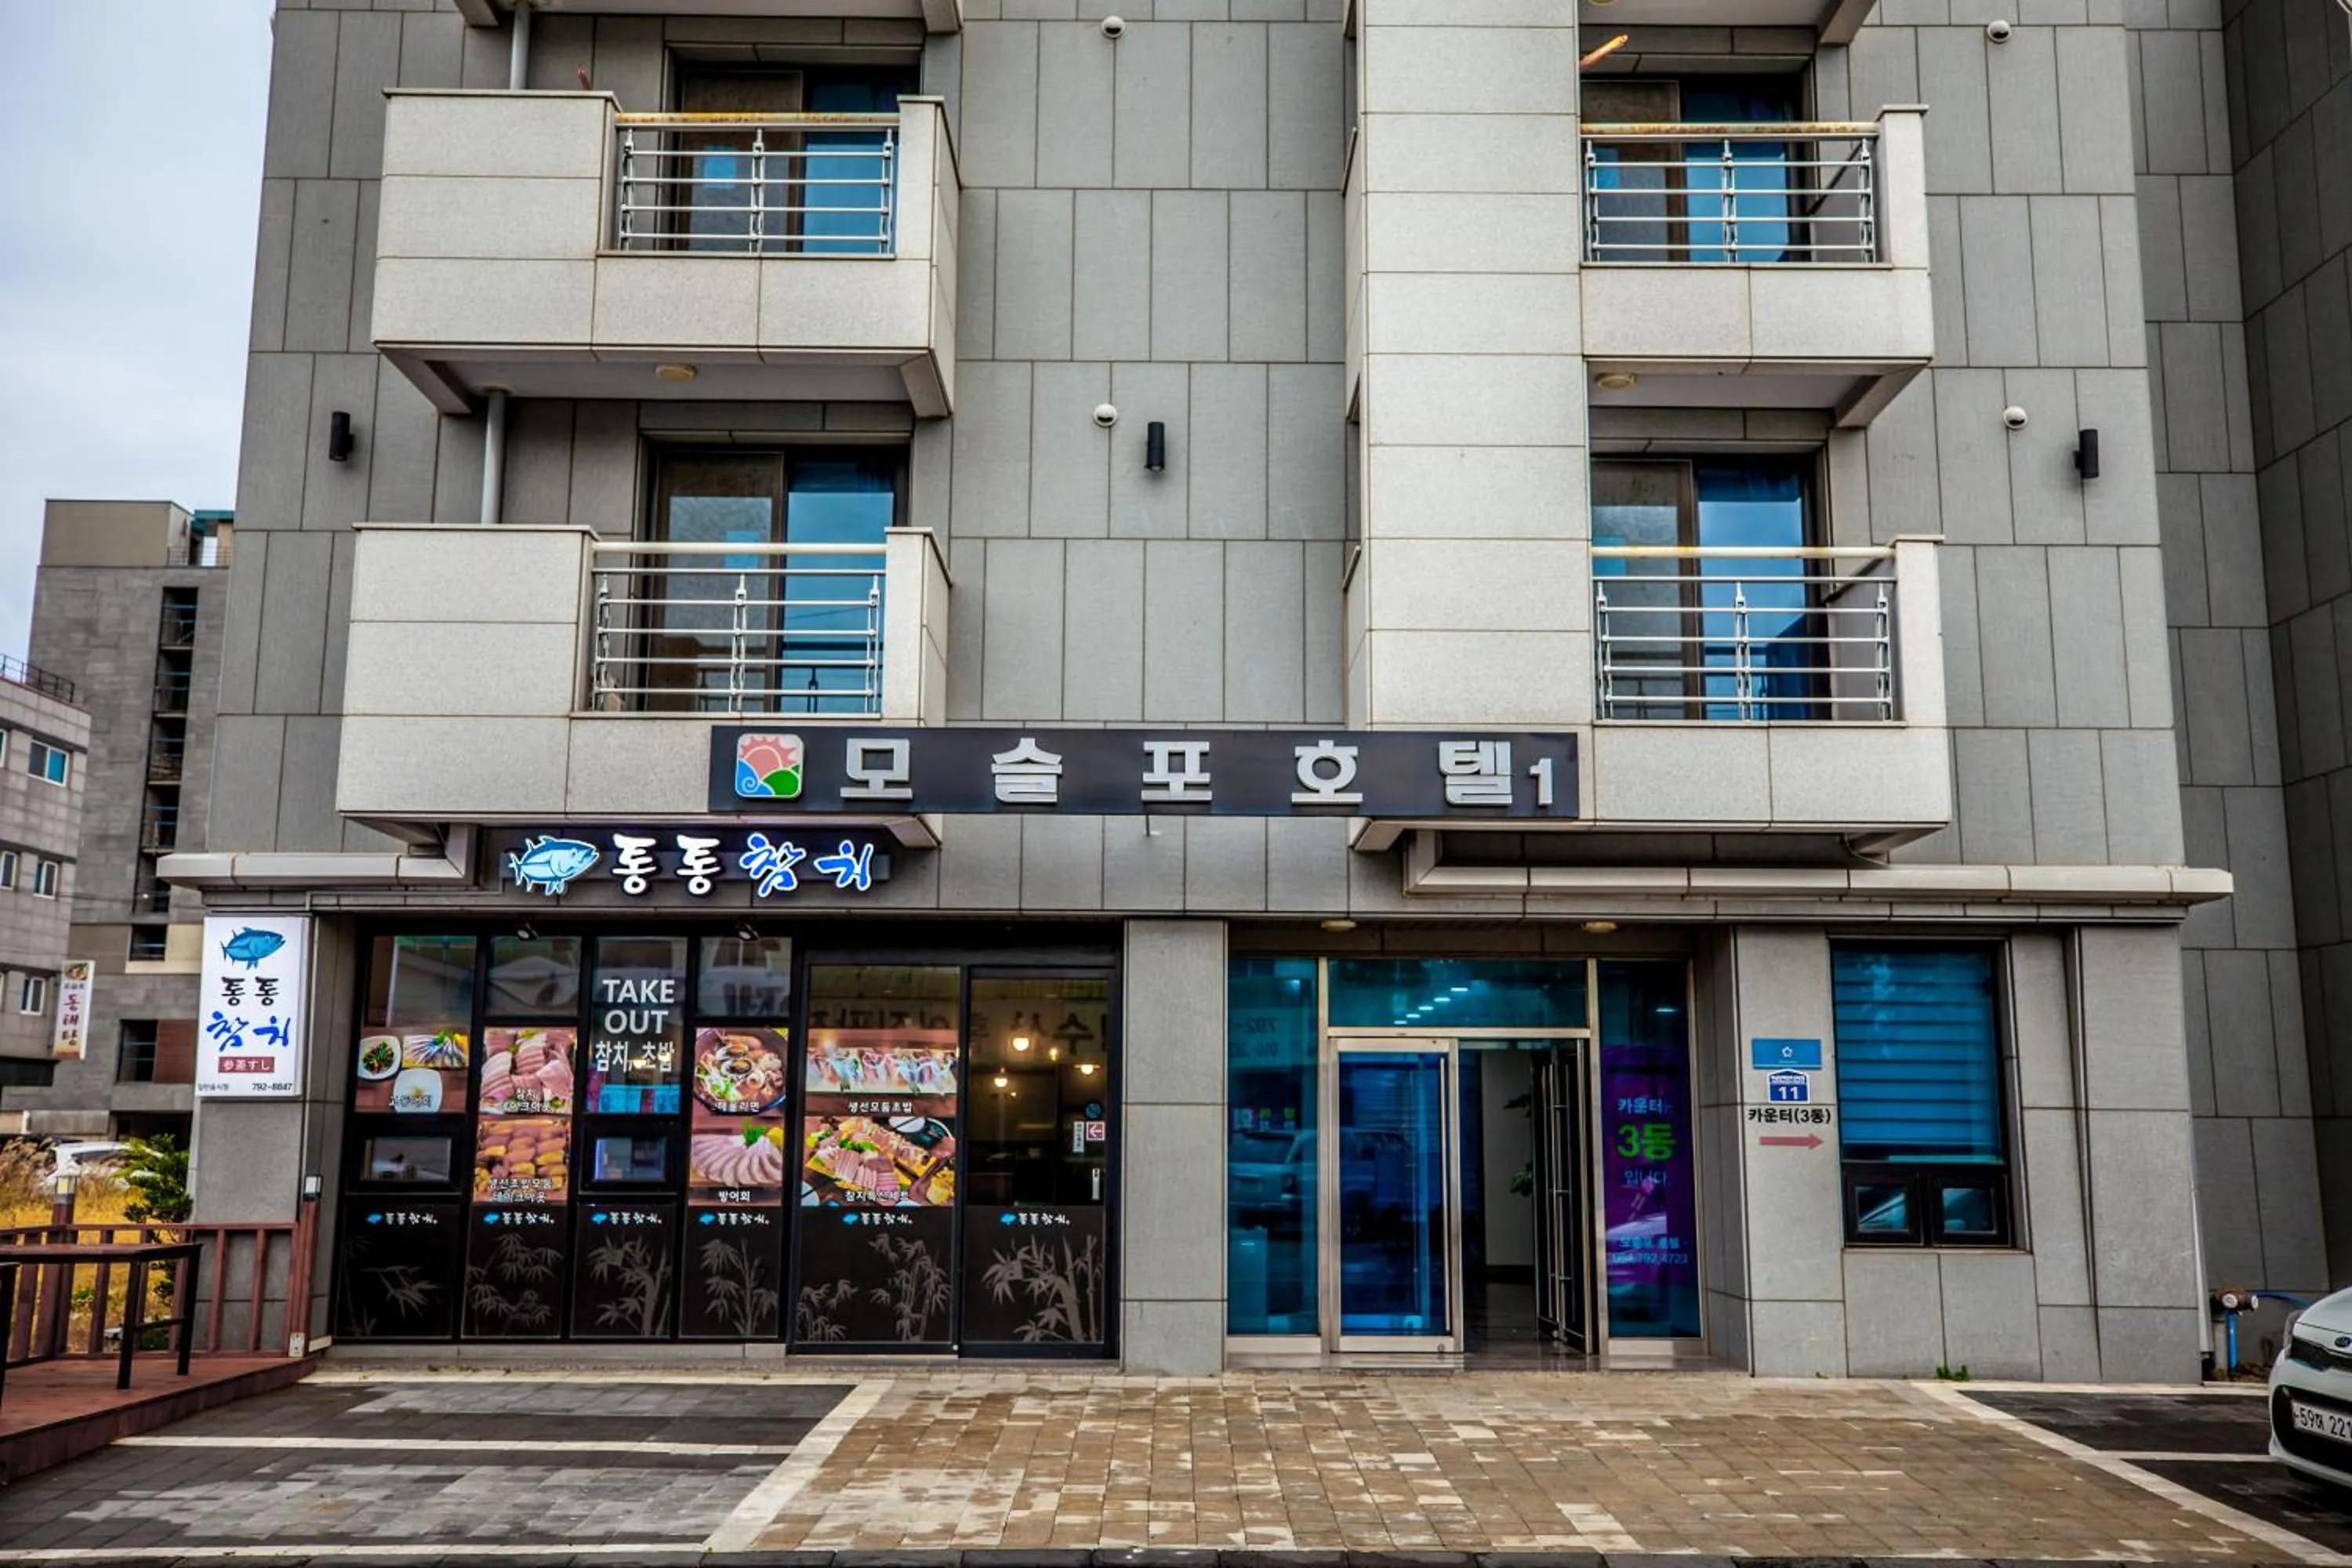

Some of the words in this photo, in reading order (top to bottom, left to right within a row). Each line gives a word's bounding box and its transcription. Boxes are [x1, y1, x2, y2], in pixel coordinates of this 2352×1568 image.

[221, 976, 279, 1007] 통통
[602, 979, 675, 1003] TAKE
[206, 1011, 291, 1052] 참치
[604, 1009, 669, 1034] OUT
[641, 1040, 675, 1073] 초밥
[1778, 1086, 1798, 1100] 11
[1748, 1107, 1831, 1124] 카운터(3동)
[1617, 1123, 1676, 1160] 3동
